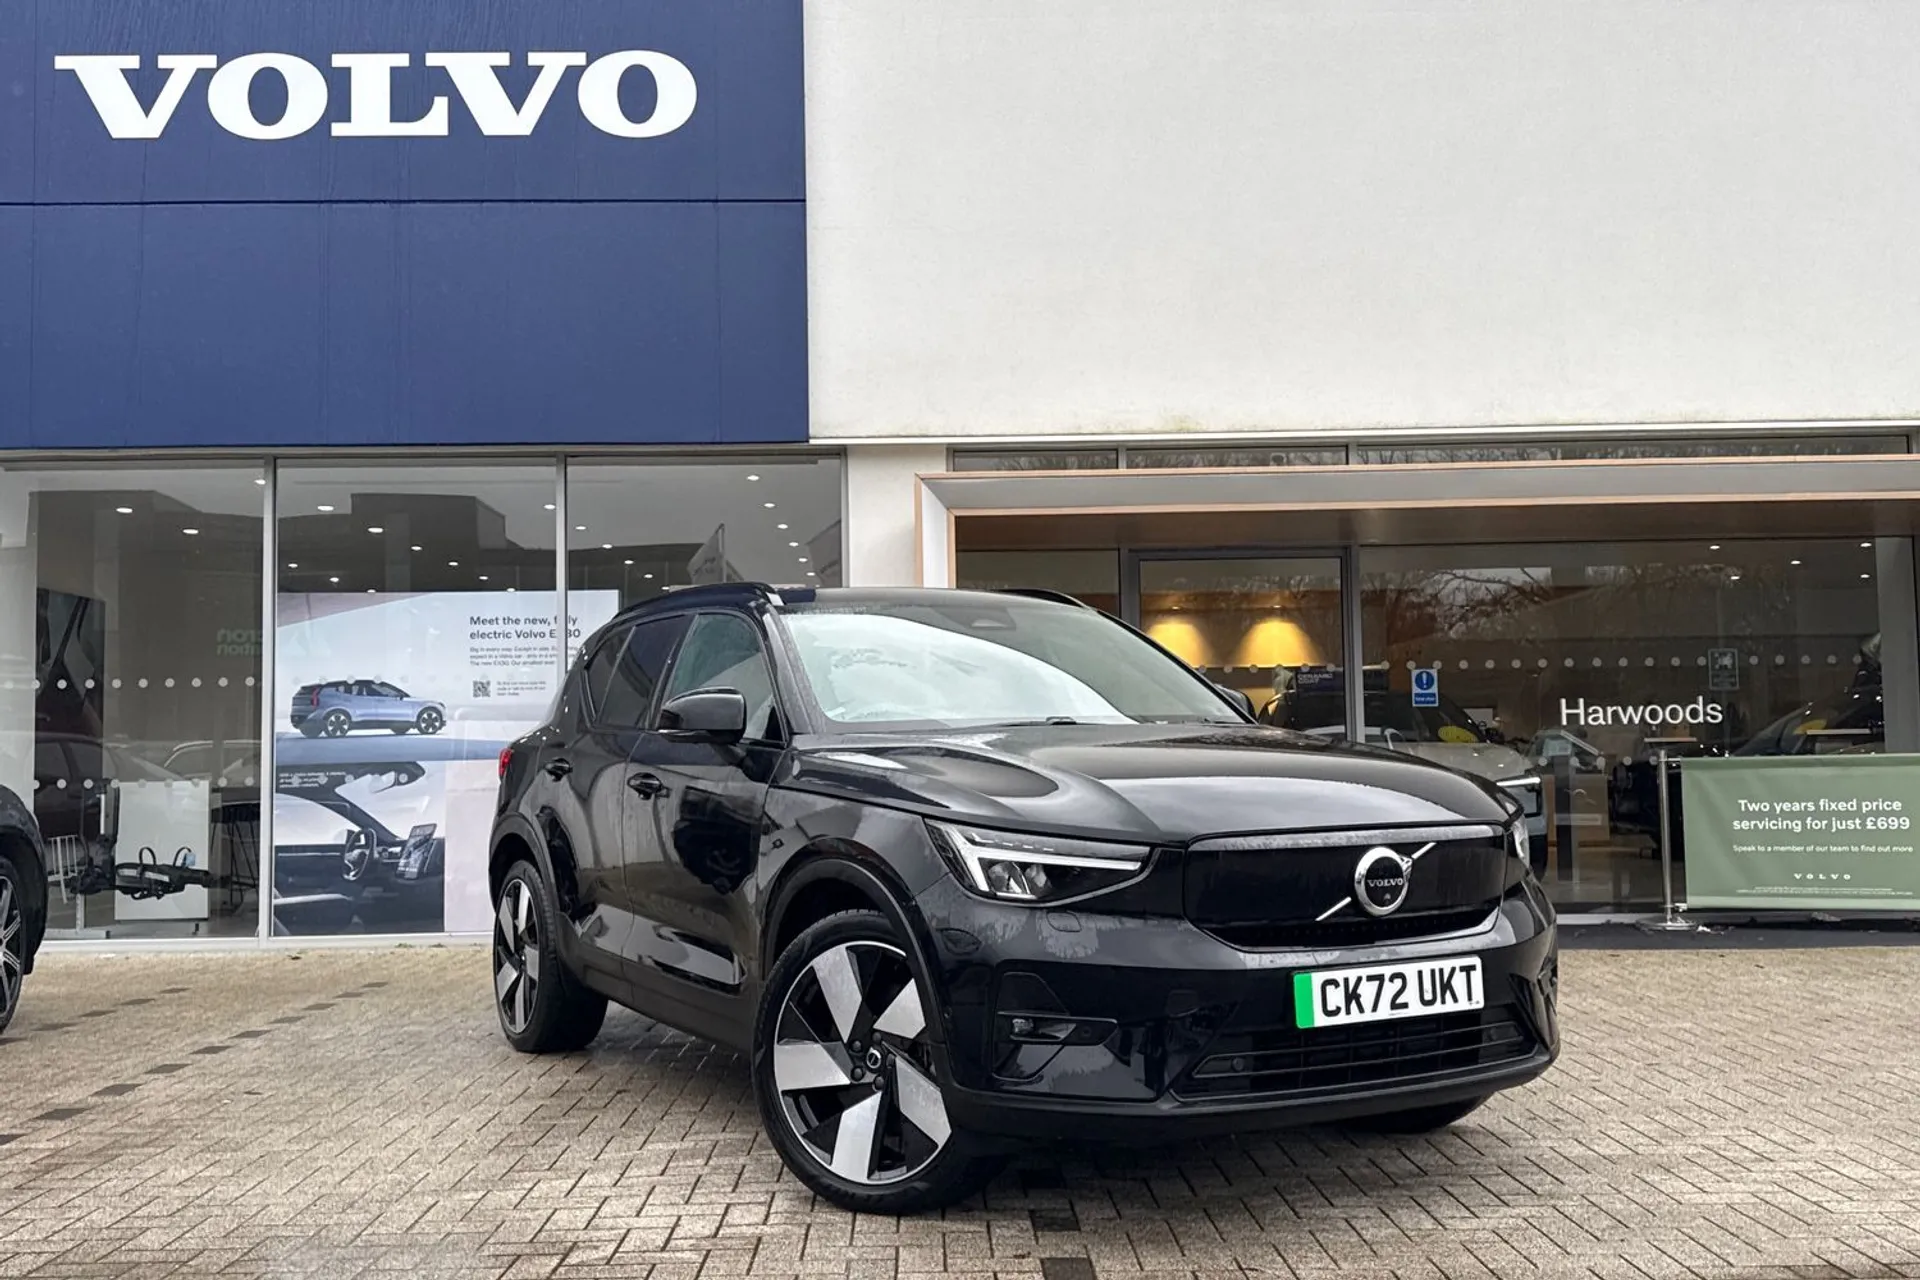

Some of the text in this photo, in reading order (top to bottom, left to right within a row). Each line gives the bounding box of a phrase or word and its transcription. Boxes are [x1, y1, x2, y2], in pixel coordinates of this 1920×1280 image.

[54, 50, 698, 140] VOLVO
[470, 615, 578, 626] Meet the new, fly
[470, 628, 581, 639] electric Volvo E30
[1560, 695, 1723, 726] Harwoods
[1738, 798, 1902, 814] Two years fixed price
[1732, 816, 1910, 832] servicing for just £699
[1367, 877, 1404, 888] VOLVO
[1320, 964, 1477, 1018] CK72 UKT
